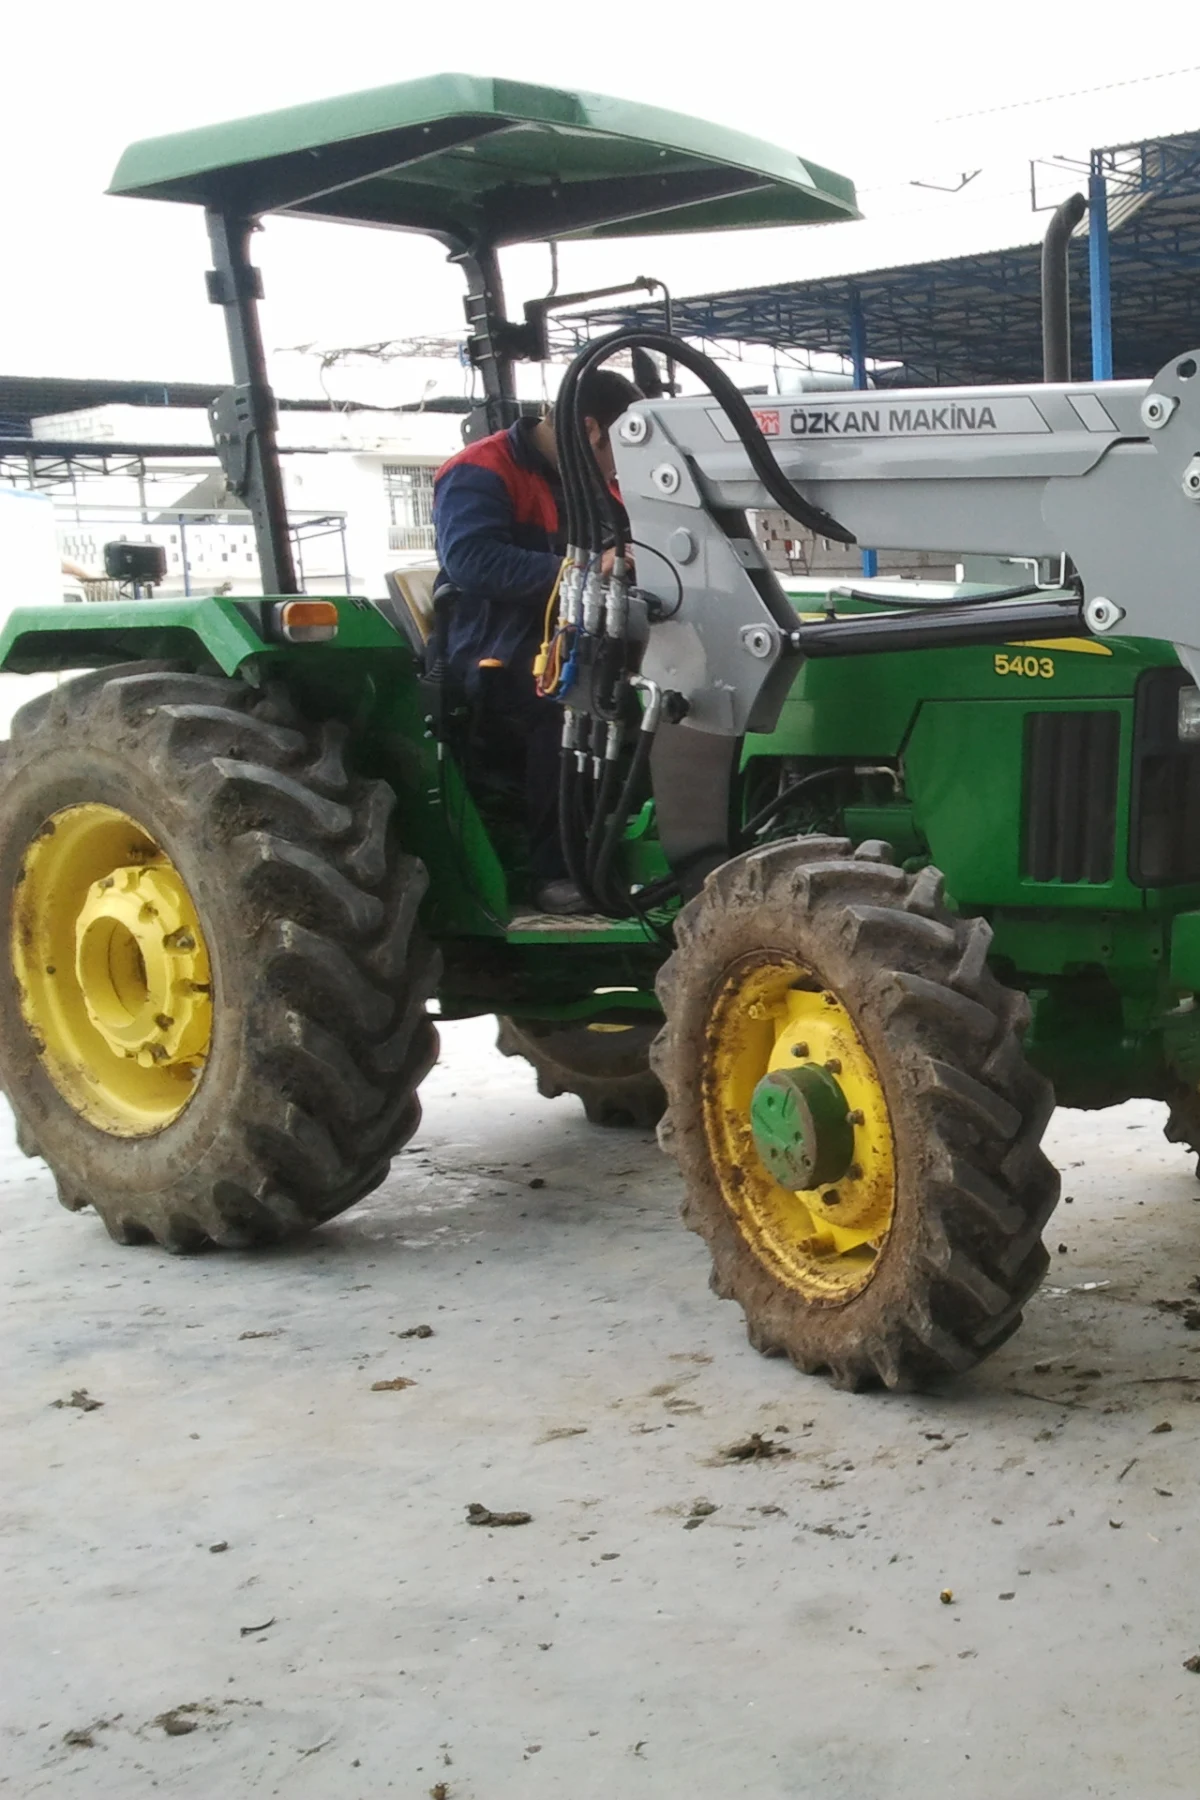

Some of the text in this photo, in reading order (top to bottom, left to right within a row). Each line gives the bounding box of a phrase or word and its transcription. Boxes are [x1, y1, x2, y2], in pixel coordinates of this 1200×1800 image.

[790, 408, 880, 434] ÖZKAN
[889, 403, 997, 431] MAKİNA
[994, 653, 1055, 679] 5403
